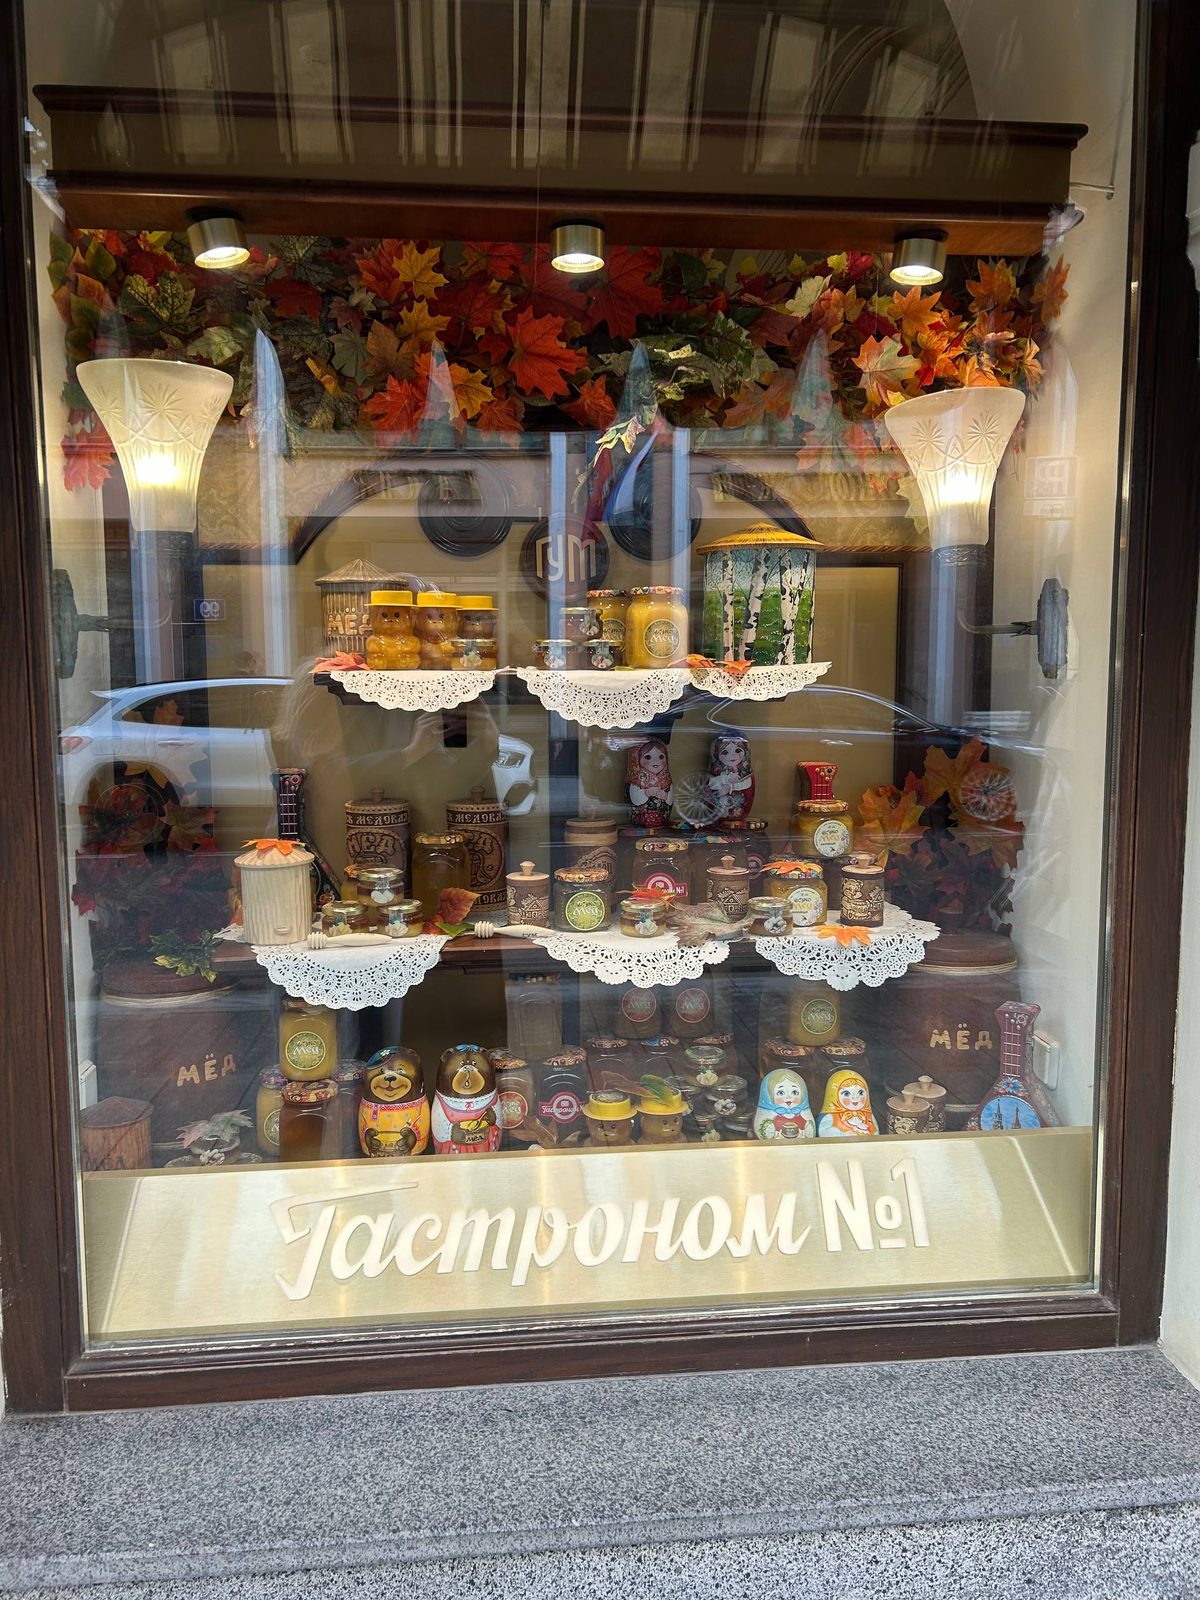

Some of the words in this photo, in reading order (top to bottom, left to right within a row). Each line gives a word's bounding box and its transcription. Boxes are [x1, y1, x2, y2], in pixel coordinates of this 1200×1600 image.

[930, 1022, 993, 1050] МЁД
[177, 1053, 236, 1087] МЁД
[269, 1181, 811, 1301] Гастроном
[816, 1157, 930, 1252] №1
